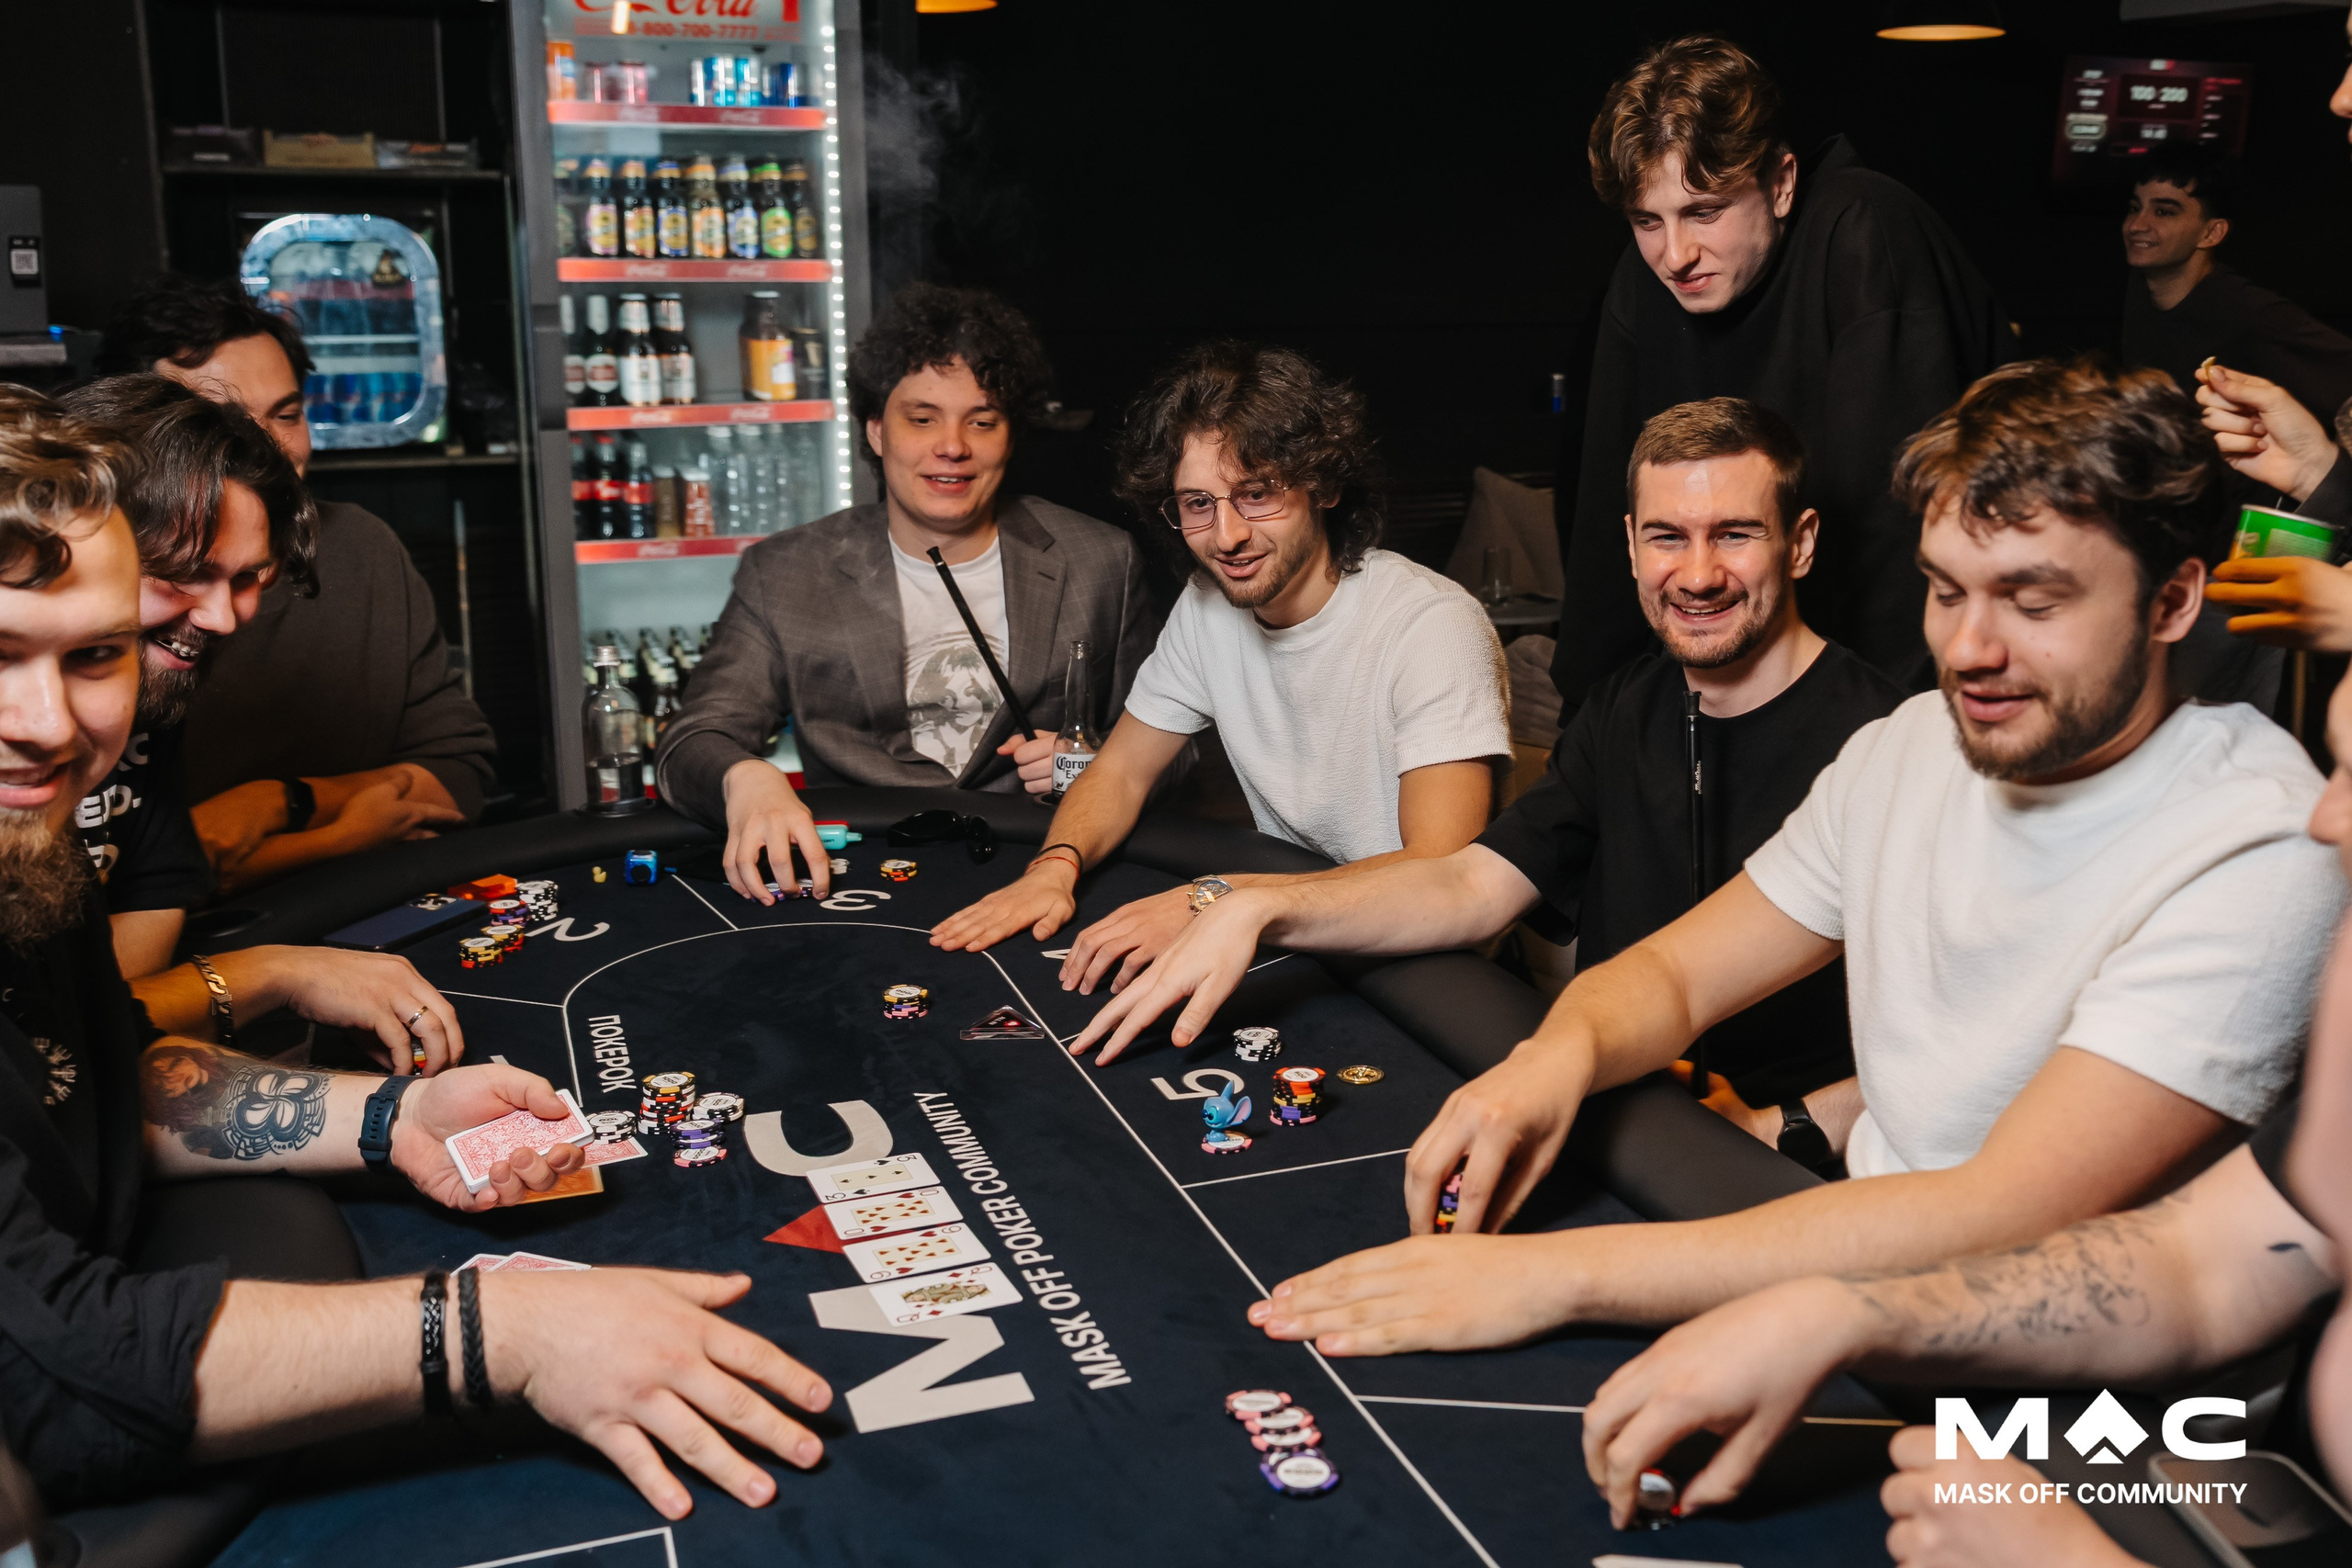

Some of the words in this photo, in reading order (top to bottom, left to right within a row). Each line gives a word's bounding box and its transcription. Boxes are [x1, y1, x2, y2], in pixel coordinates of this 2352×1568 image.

[820, 889, 892, 911] 3
[524, 917, 610, 942] 2
[588, 1014, 637, 1093] ПОКЕРОК
[1150, 1067, 1245, 1101] 5
[913, 1092, 1008, 1194] COMMUNITY
[980, 1195, 1055, 1266] POKER
[1021, 1268, 1081, 1311] OFF
[1049, 1311, 1132, 1391] MASK
